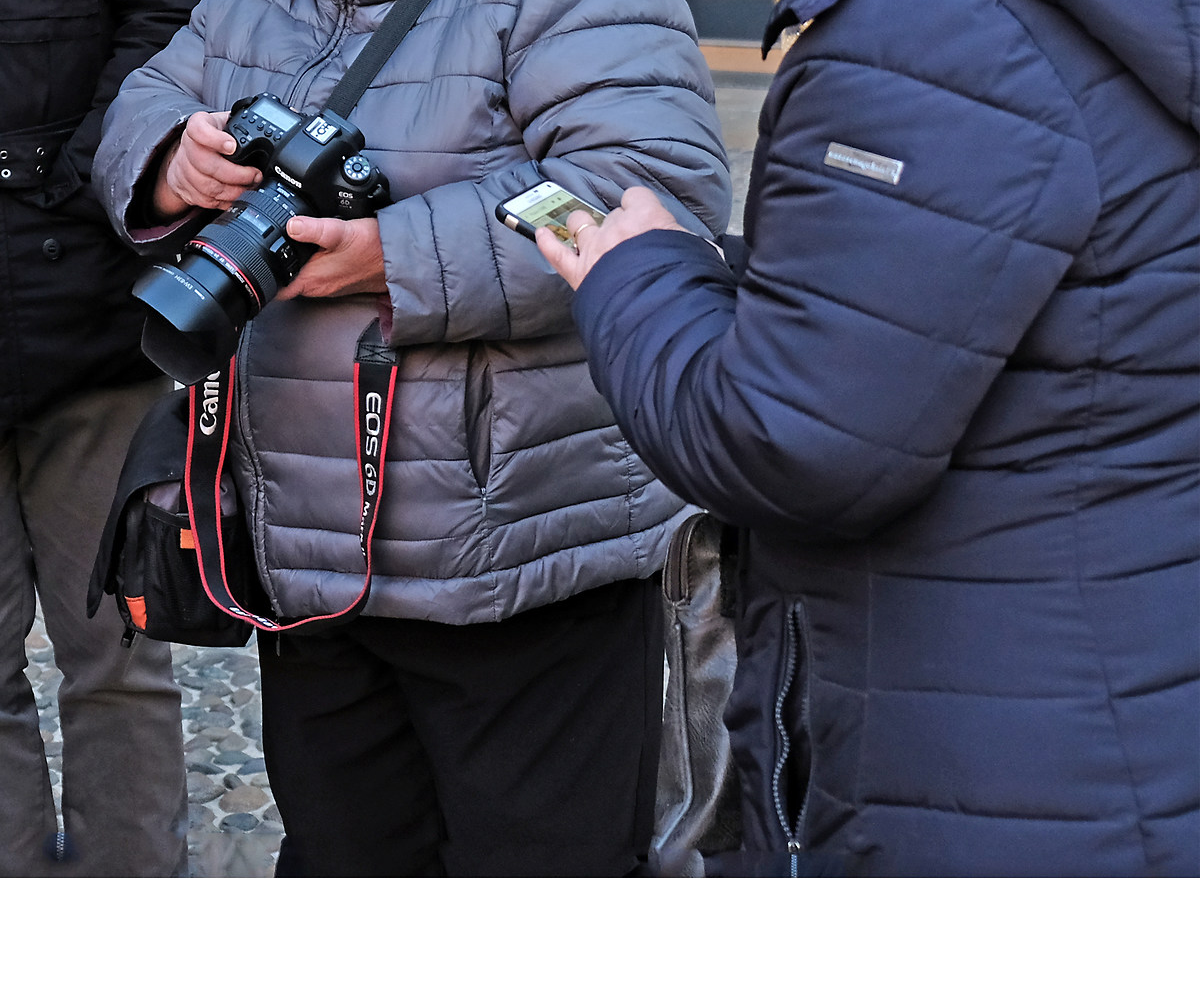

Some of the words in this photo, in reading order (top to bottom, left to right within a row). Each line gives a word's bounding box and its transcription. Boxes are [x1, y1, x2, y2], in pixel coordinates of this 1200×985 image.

[274, 165, 302, 189] Canon
[338, 191, 354, 199] EOS
[199, 370, 221, 436] Can
[365, 391, 382, 457] EOS
[364, 463, 377, 497] 6D
